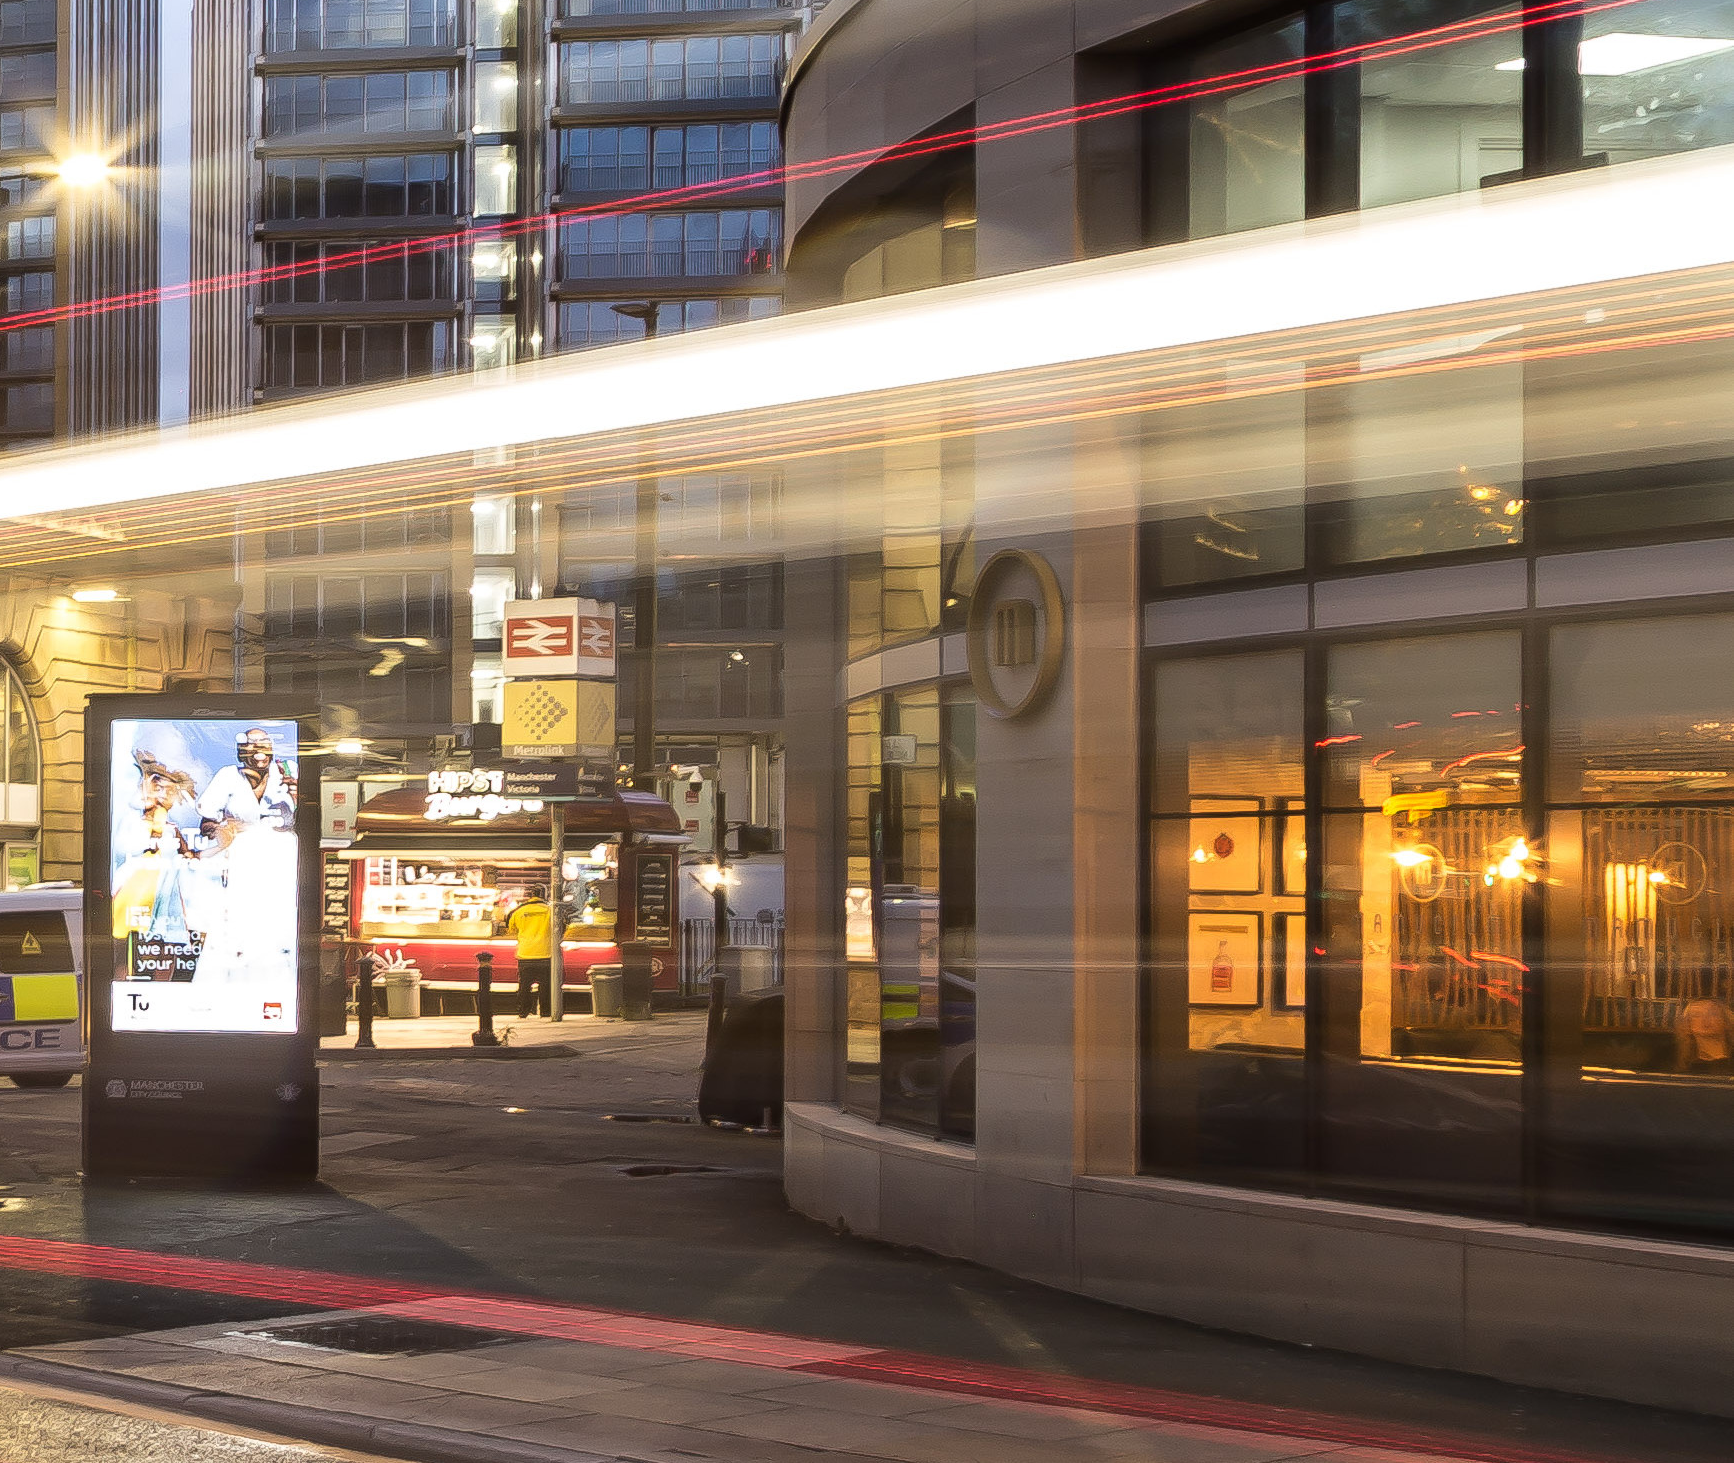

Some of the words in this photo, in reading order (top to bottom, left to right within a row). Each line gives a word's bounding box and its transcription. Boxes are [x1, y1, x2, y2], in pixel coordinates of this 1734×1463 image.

[512, 744, 565, 756] Metrolink
[427, 768, 505, 794] HIPST
[506, 772, 558, 782] Manchester
[506, 784, 541, 794] Victoria
[137, 943, 161, 956] we
[163, 941, 203, 956] need
[136, 958, 173, 973] your
[176, 957, 200, 970] hel
[126, 993, 150, 1012] Tu
